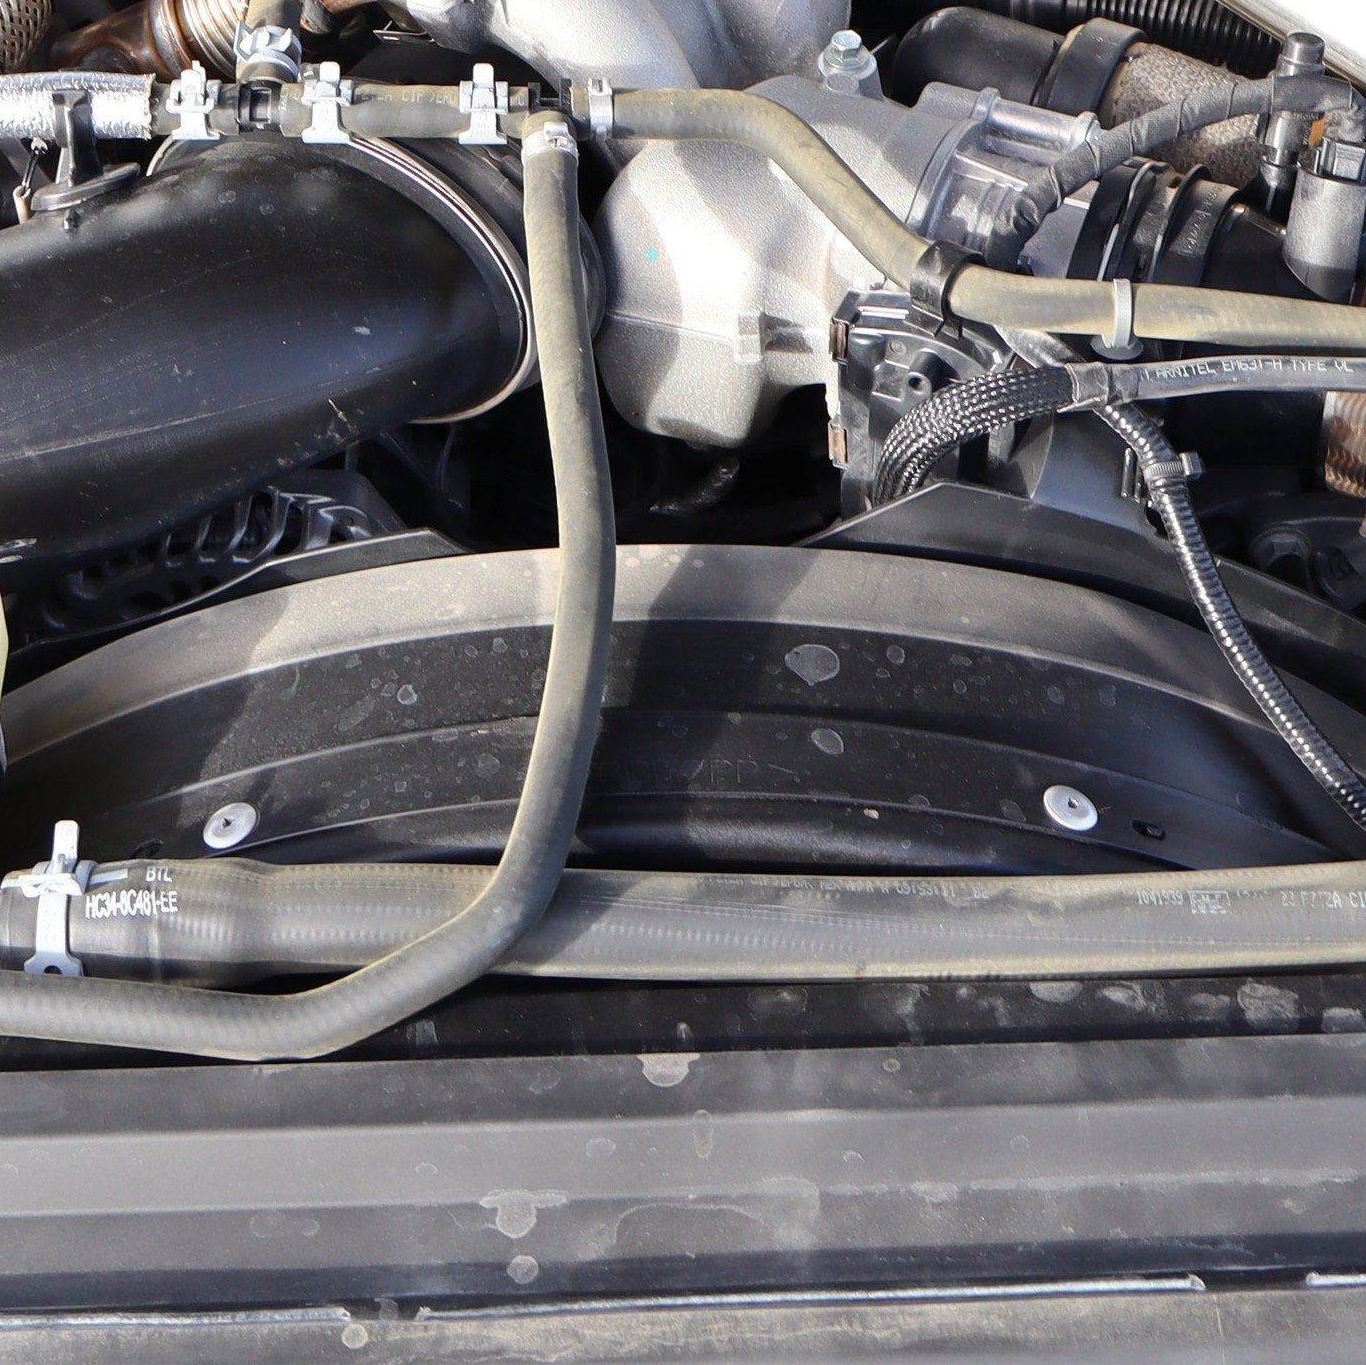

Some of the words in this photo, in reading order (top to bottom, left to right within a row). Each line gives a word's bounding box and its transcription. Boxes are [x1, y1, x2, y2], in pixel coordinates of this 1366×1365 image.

[1156, 364, 1216, 379] ARNITEL
[1289, 359, 1327, 372] TYPE
[1335, 360, 1353, 373] VL
[145, 865, 173, 883] BTL
